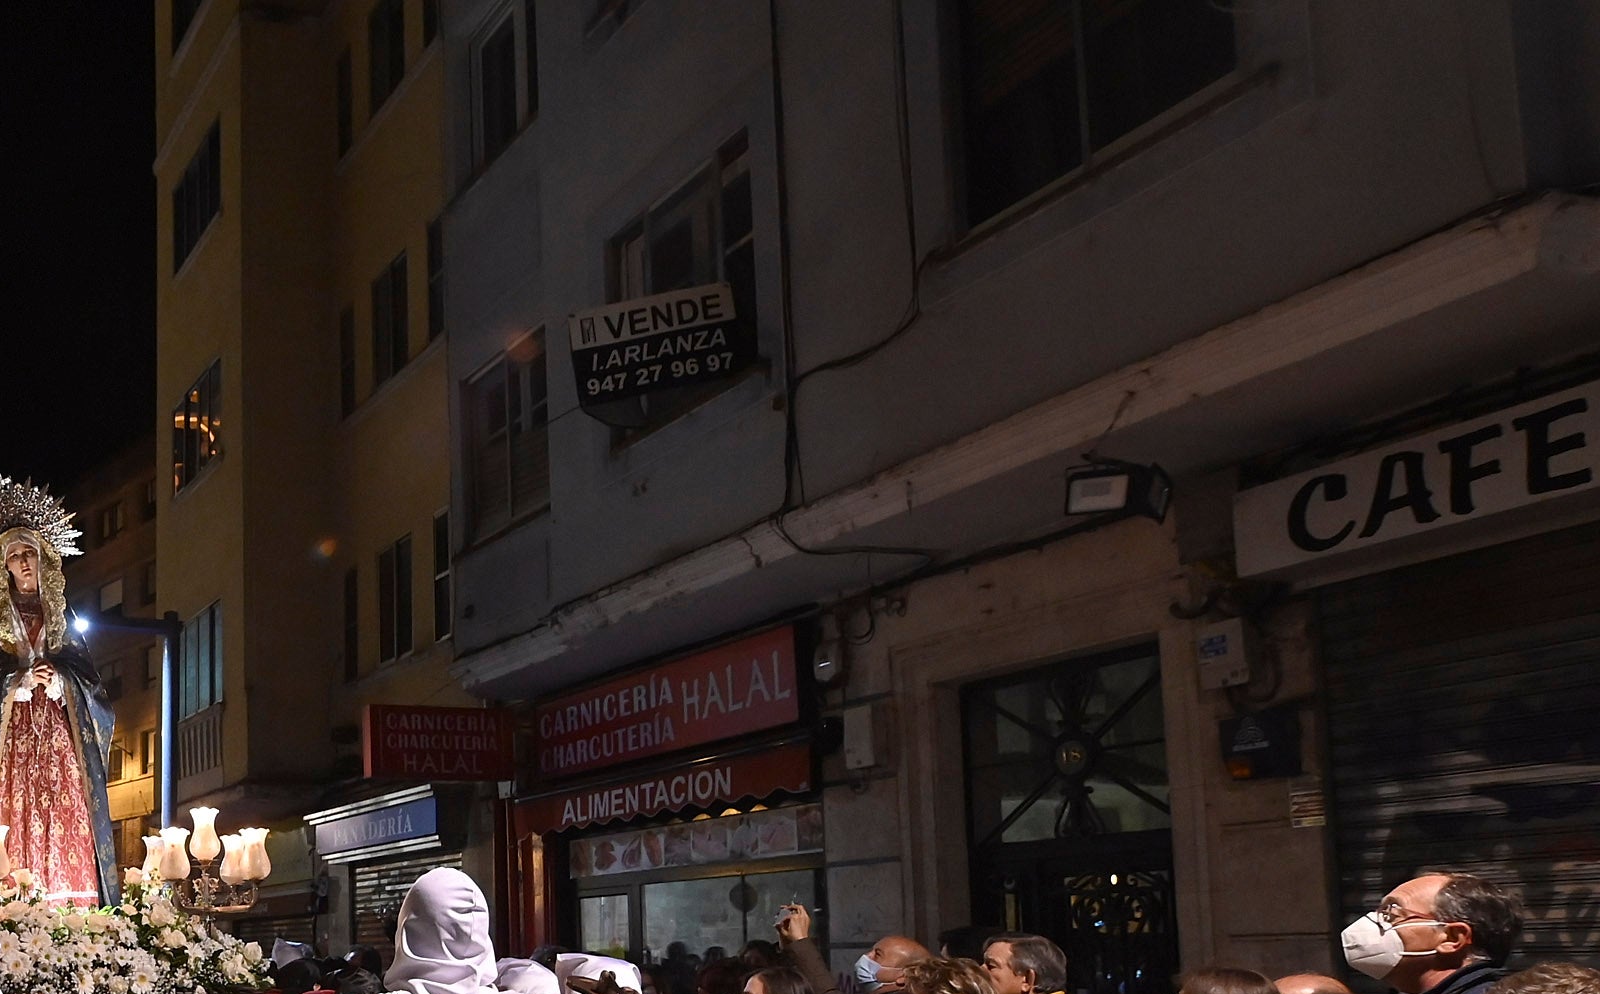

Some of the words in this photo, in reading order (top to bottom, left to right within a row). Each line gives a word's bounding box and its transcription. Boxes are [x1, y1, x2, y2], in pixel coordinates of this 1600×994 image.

[604, 294, 723, 338] VENDE
[592, 328, 727, 371] I.ARLANZA
[586, 372, 627, 396] 947
[635, 364, 663, 386] 27
[670, 358, 699, 378] 96
[706, 352, 734, 372] 97
[1287, 398, 1592, 552] CAFE
[540, 673, 674, 739] CARNICERÍA
[681, 650, 792, 724] HALAL
[386, 711, 497, 732] CARNICERÍA
[387, 732, 498, 751] CHARCUTERÍA
[540, 713, 676, 770] CHARCUTERÍA
[403, 752, 484, 774] HALAL
[561, 766, 732, 825] ALIMENTACION
[333, 808, 413, 846] PANADERÍA
